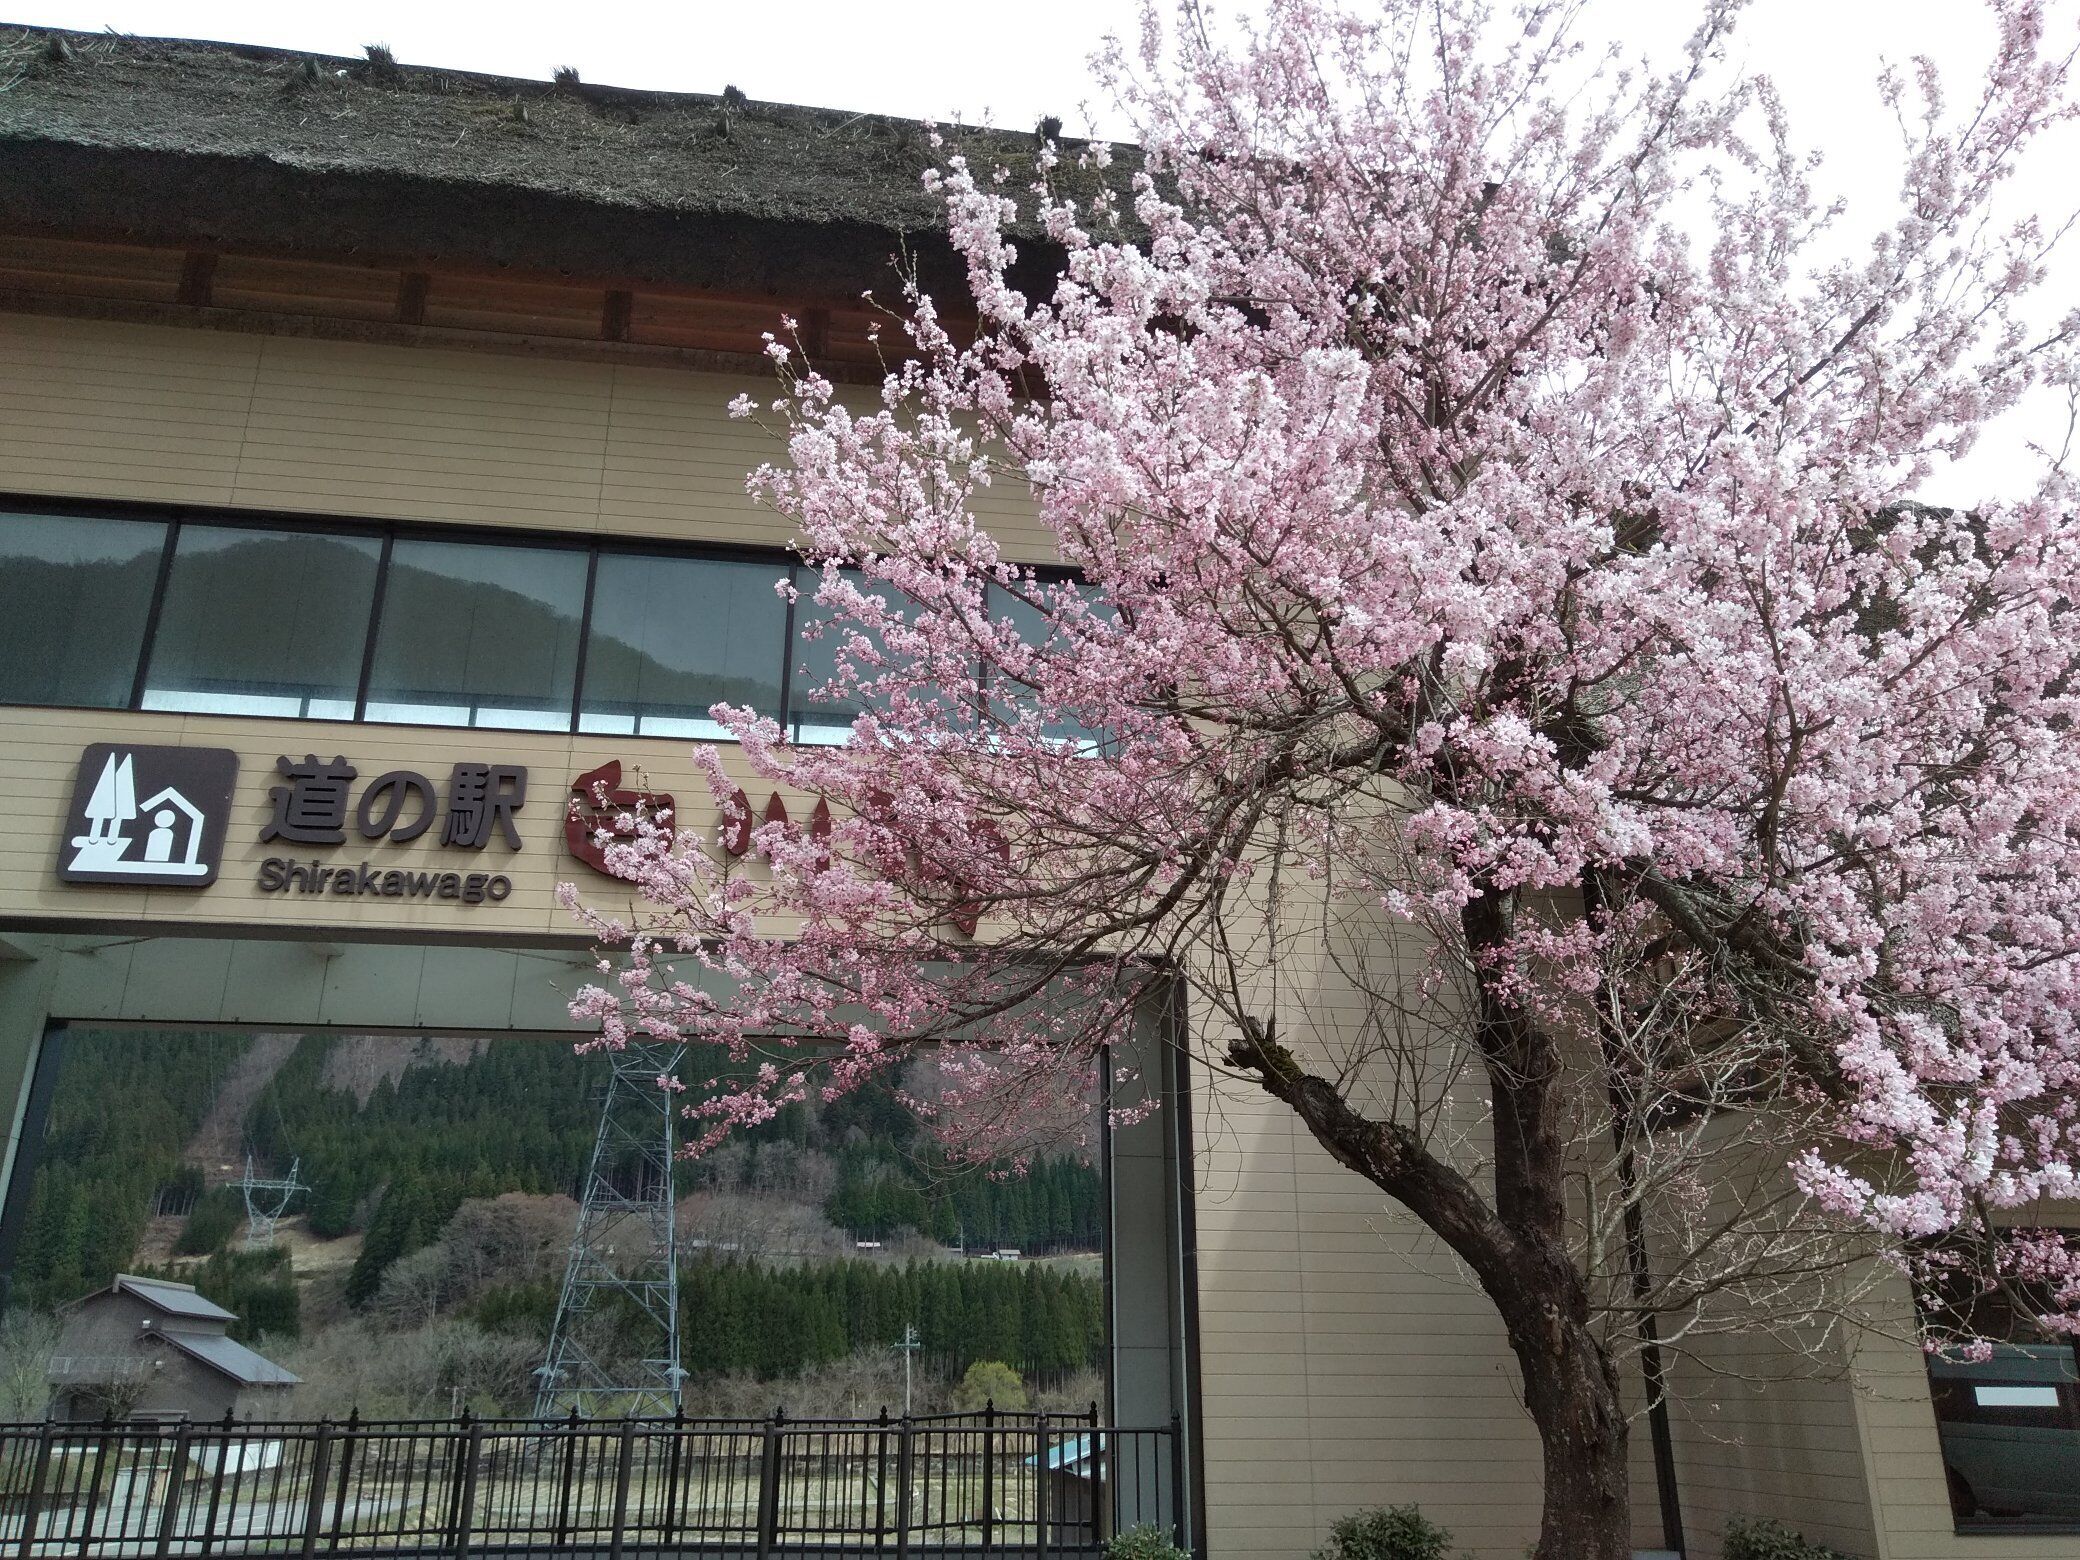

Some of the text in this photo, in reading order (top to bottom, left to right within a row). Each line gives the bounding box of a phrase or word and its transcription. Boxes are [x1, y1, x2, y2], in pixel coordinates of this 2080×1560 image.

[258, 754, 528, 851] 道の駅
[258, 858, 512, 902] Shirakawago
